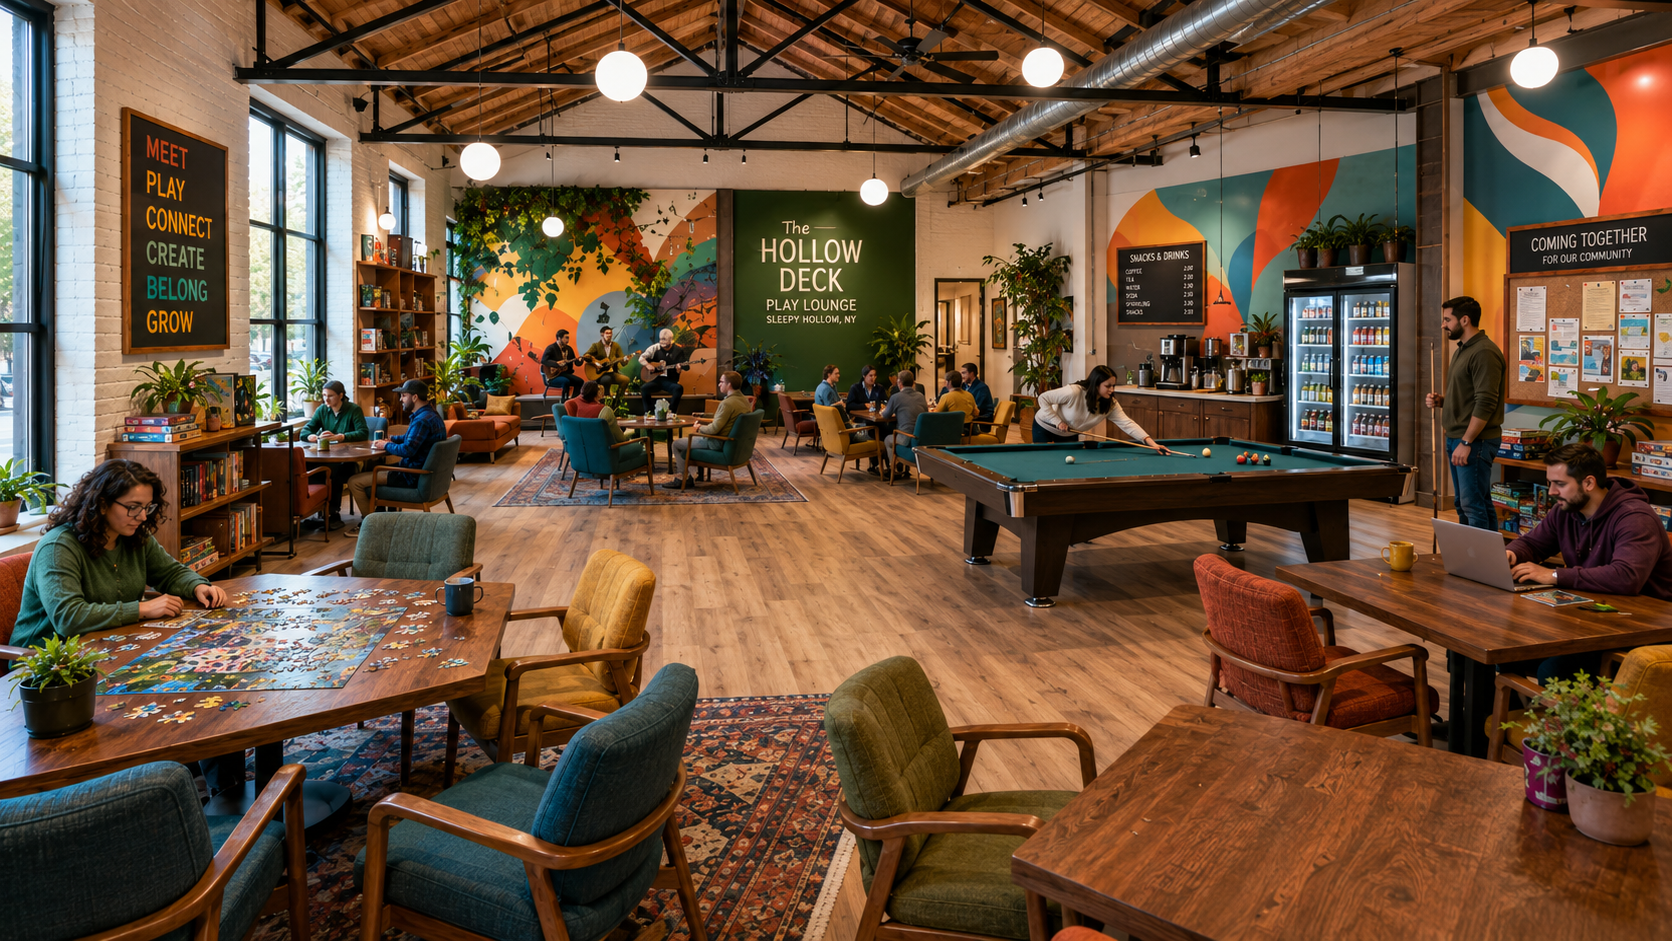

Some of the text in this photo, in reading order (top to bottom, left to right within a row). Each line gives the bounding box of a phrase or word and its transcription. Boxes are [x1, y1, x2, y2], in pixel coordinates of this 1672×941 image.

[146, 135, 188, 169] MEET
[146, 170, 185, 201] PLAY
[146, 206, 212, 239] CONNECT
[781, 220, 811, 235] The
[761, 238, 863, 263] HOLLOW
[1530, 226, 1648, 252] COMING TOGETHER
[146, 240, 204, 270] CREATE
[1130, 250, 1190, 263] SNACKS & DRINKS
[1542, 248, 1633, 265] FOR OUR COMMUNITY
[146, 275, 208, 302] BELONG
[780, 267, 844, 292] DECK
[766, 298, 857, 312] PLAY LOUNGE
[146, 309, 194, 334] GROW
[766, 315, 800, 324] SLEEPY
[844, 315, 857, 324] NY
